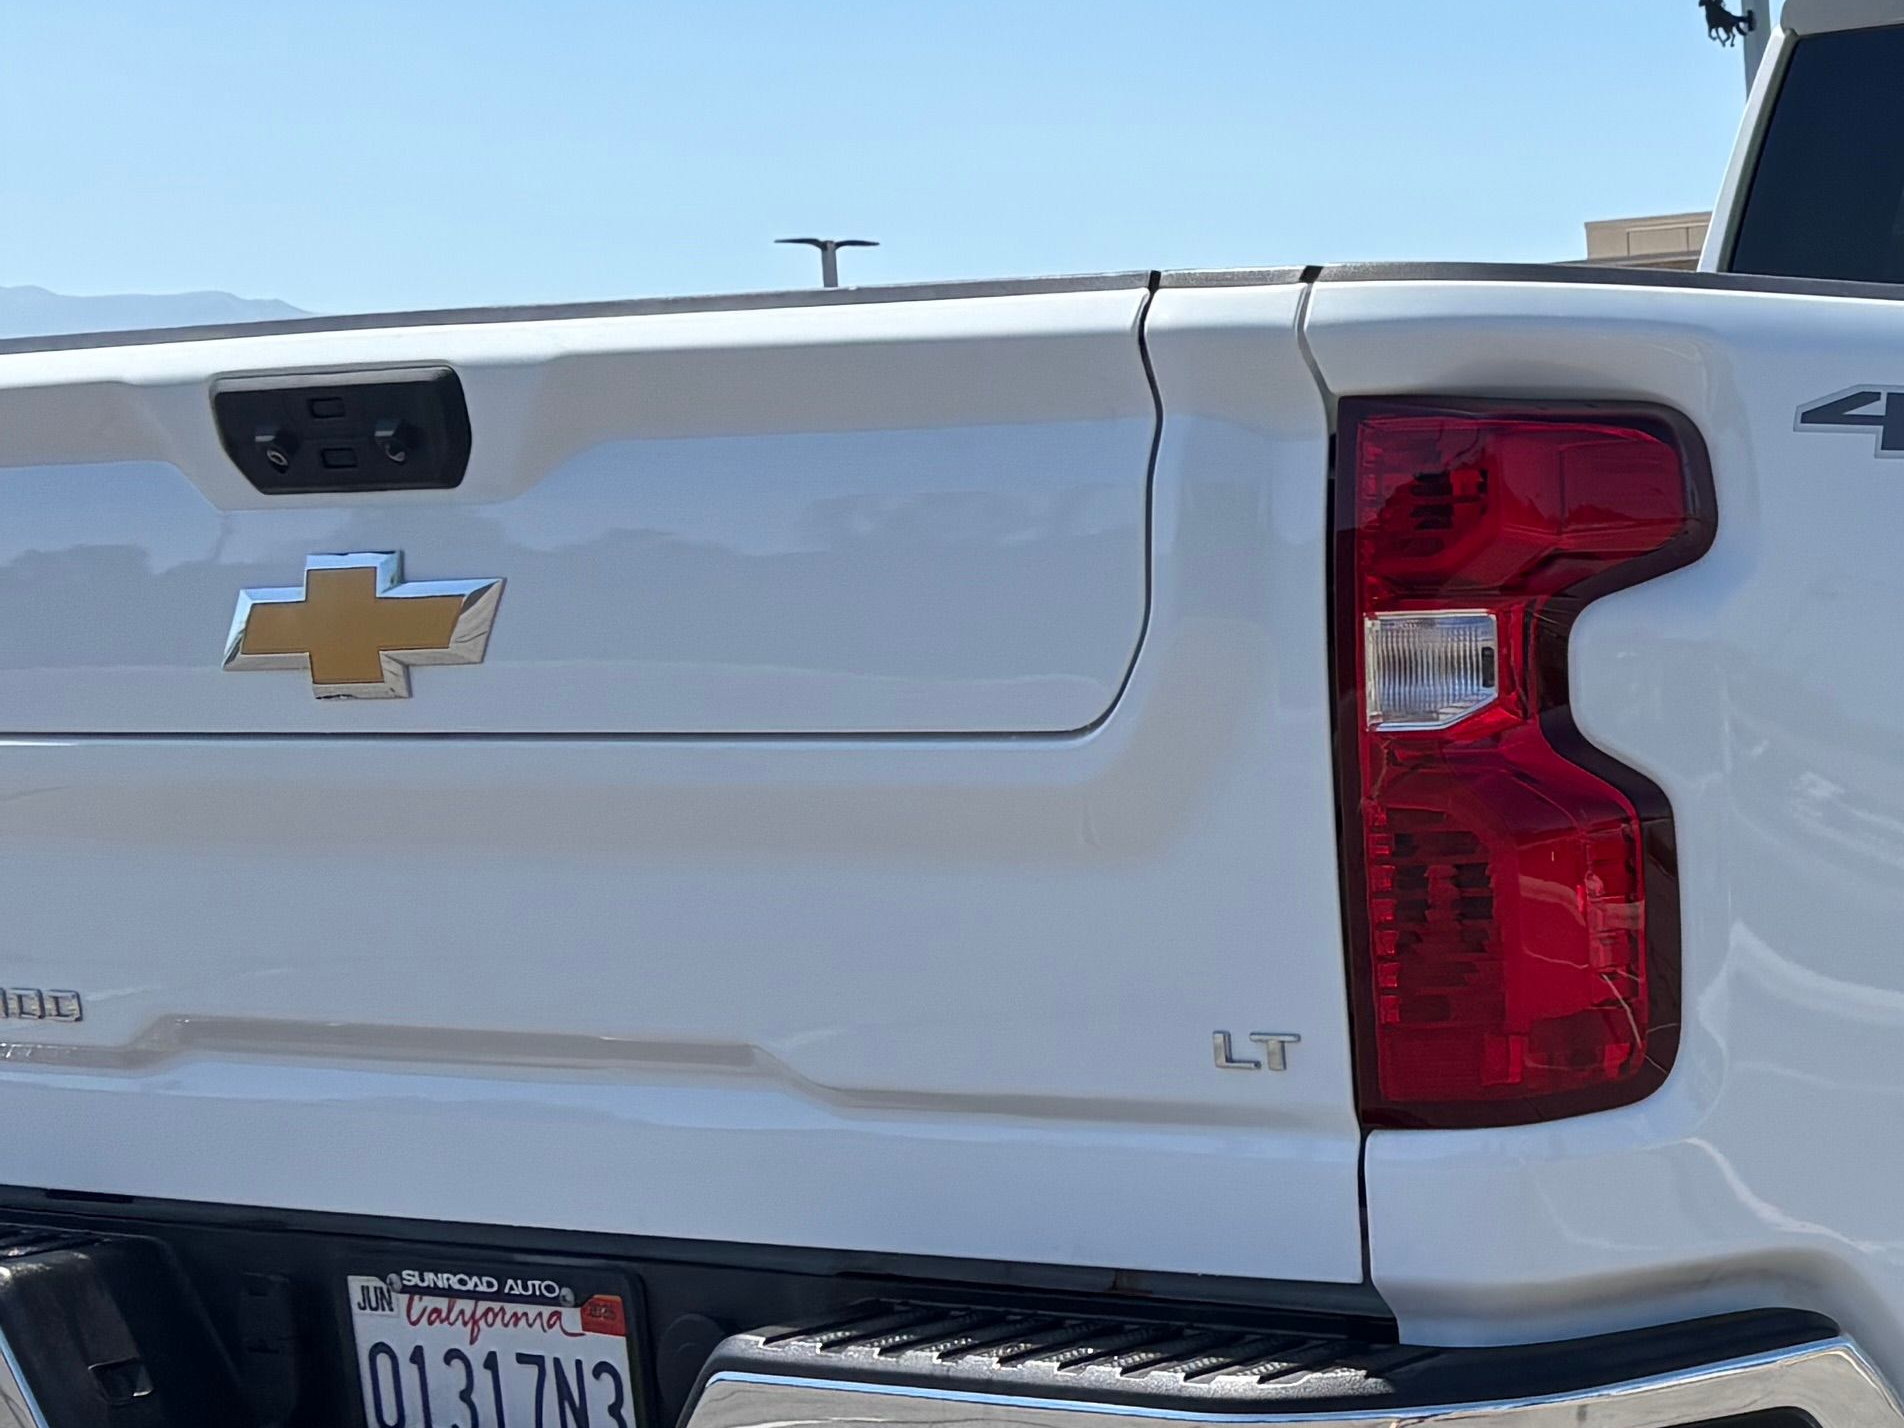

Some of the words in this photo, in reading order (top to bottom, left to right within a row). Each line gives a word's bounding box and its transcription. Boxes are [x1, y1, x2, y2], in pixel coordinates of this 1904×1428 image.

[0, 987, 83, 1022] 00
[1212, 1030, 1301, 1071] LT
[357, 1285, 396, 1313] JUN
[402, 1270, 498, 1293] SUNROAD
[504, 1278, 560, 1299] AUTO
[405, 1295, 587, 1346] California
